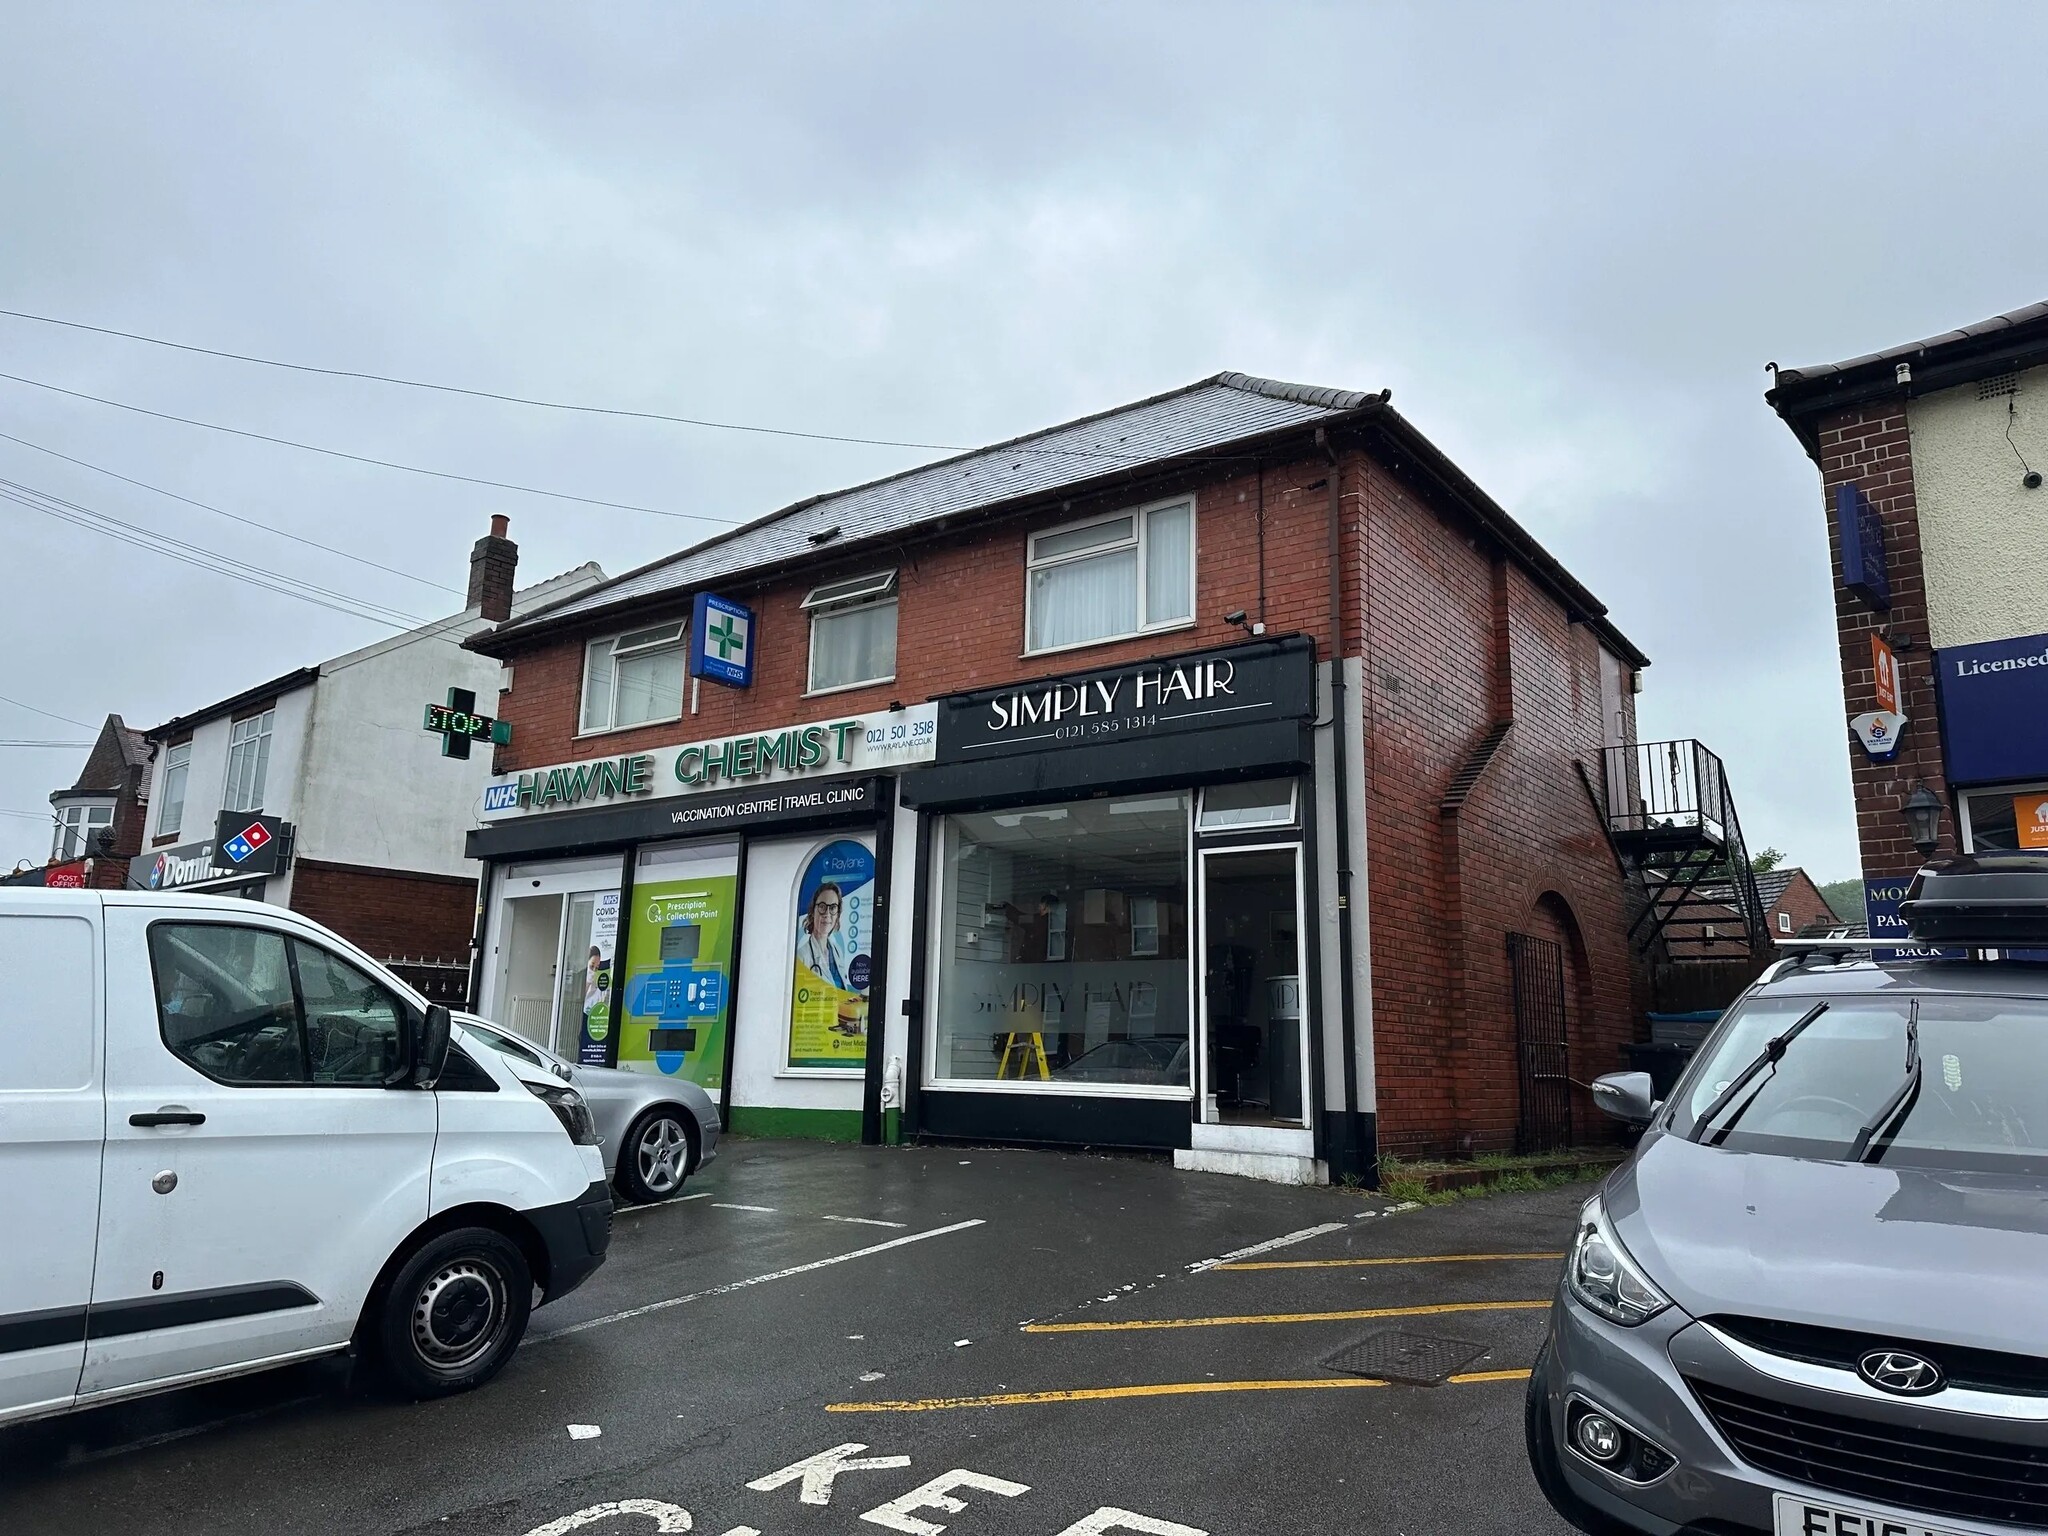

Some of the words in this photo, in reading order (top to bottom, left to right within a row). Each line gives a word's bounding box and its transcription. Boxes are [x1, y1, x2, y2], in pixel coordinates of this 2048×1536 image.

[708, 598, 748, 618] PRESCRIPTIONS
[1956, 647, 2048, 677] Licensed
[727, 667, 743, 680] NHS
[987, 674, 1123, 731] SIMPLY
[1136, 657, 1235, 709] HAIR
[866, 728, 885, 744] 0121
[890, 725, 906, 740] 501
[912, 720, 934, 737] 3518
[1055, 724, 1084, 740] 0121
[1091, 719, 1119, 735] 585
[1125, 714, 1156, 729] 1314
[485, 785, 517, 810] NHS
[515, 754, 652, 808] HAWNE
[674, 720, 862, 785] CHEMIST
[671, 804, 735, 824] VACCINATION
[736, 799, 778, 816] CENTRE
[784, 793, 824, 809] TRAVEL
[826, 787, 865, 804] CLINIC
[831, 857, 865, 872] Raylane
[52, 880, 80, 888] OFFICE
[57, 874, 78, 882] POST
[603, 894, 618, 905] NHS
[667, 901, 707, 911] Prescription
[595, 907, 619, 917] COVID-
[666, 911, 699, 921] Collection
[700, 910, 718, 919] Point
[852, 974, 869, 982] HERE
